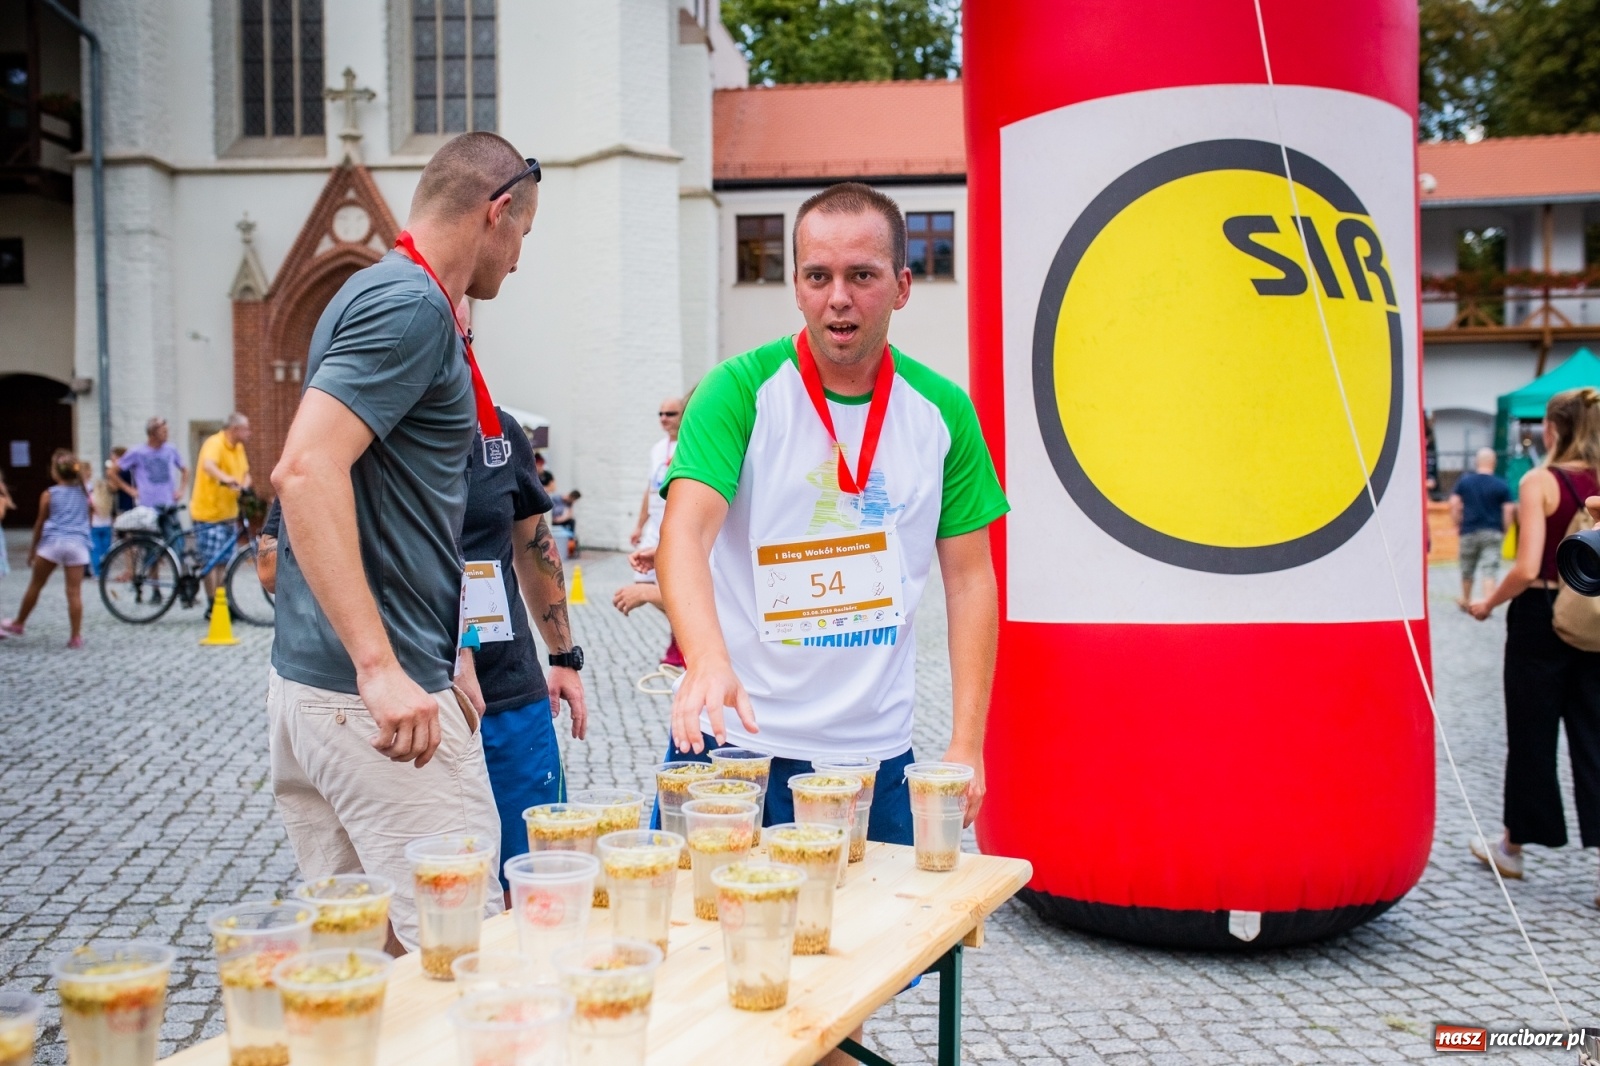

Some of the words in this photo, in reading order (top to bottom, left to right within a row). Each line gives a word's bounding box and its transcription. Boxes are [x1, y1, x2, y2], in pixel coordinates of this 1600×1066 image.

[1222, 215, 1398, 307] SIR
[781, 549, 803, 560] Bieg
[805, 546, 834, 557] Wokół
[836, 542, 871, 553] Komina
[462, 569, 484, 577] omina
[810, 570, 846, 598] 54
